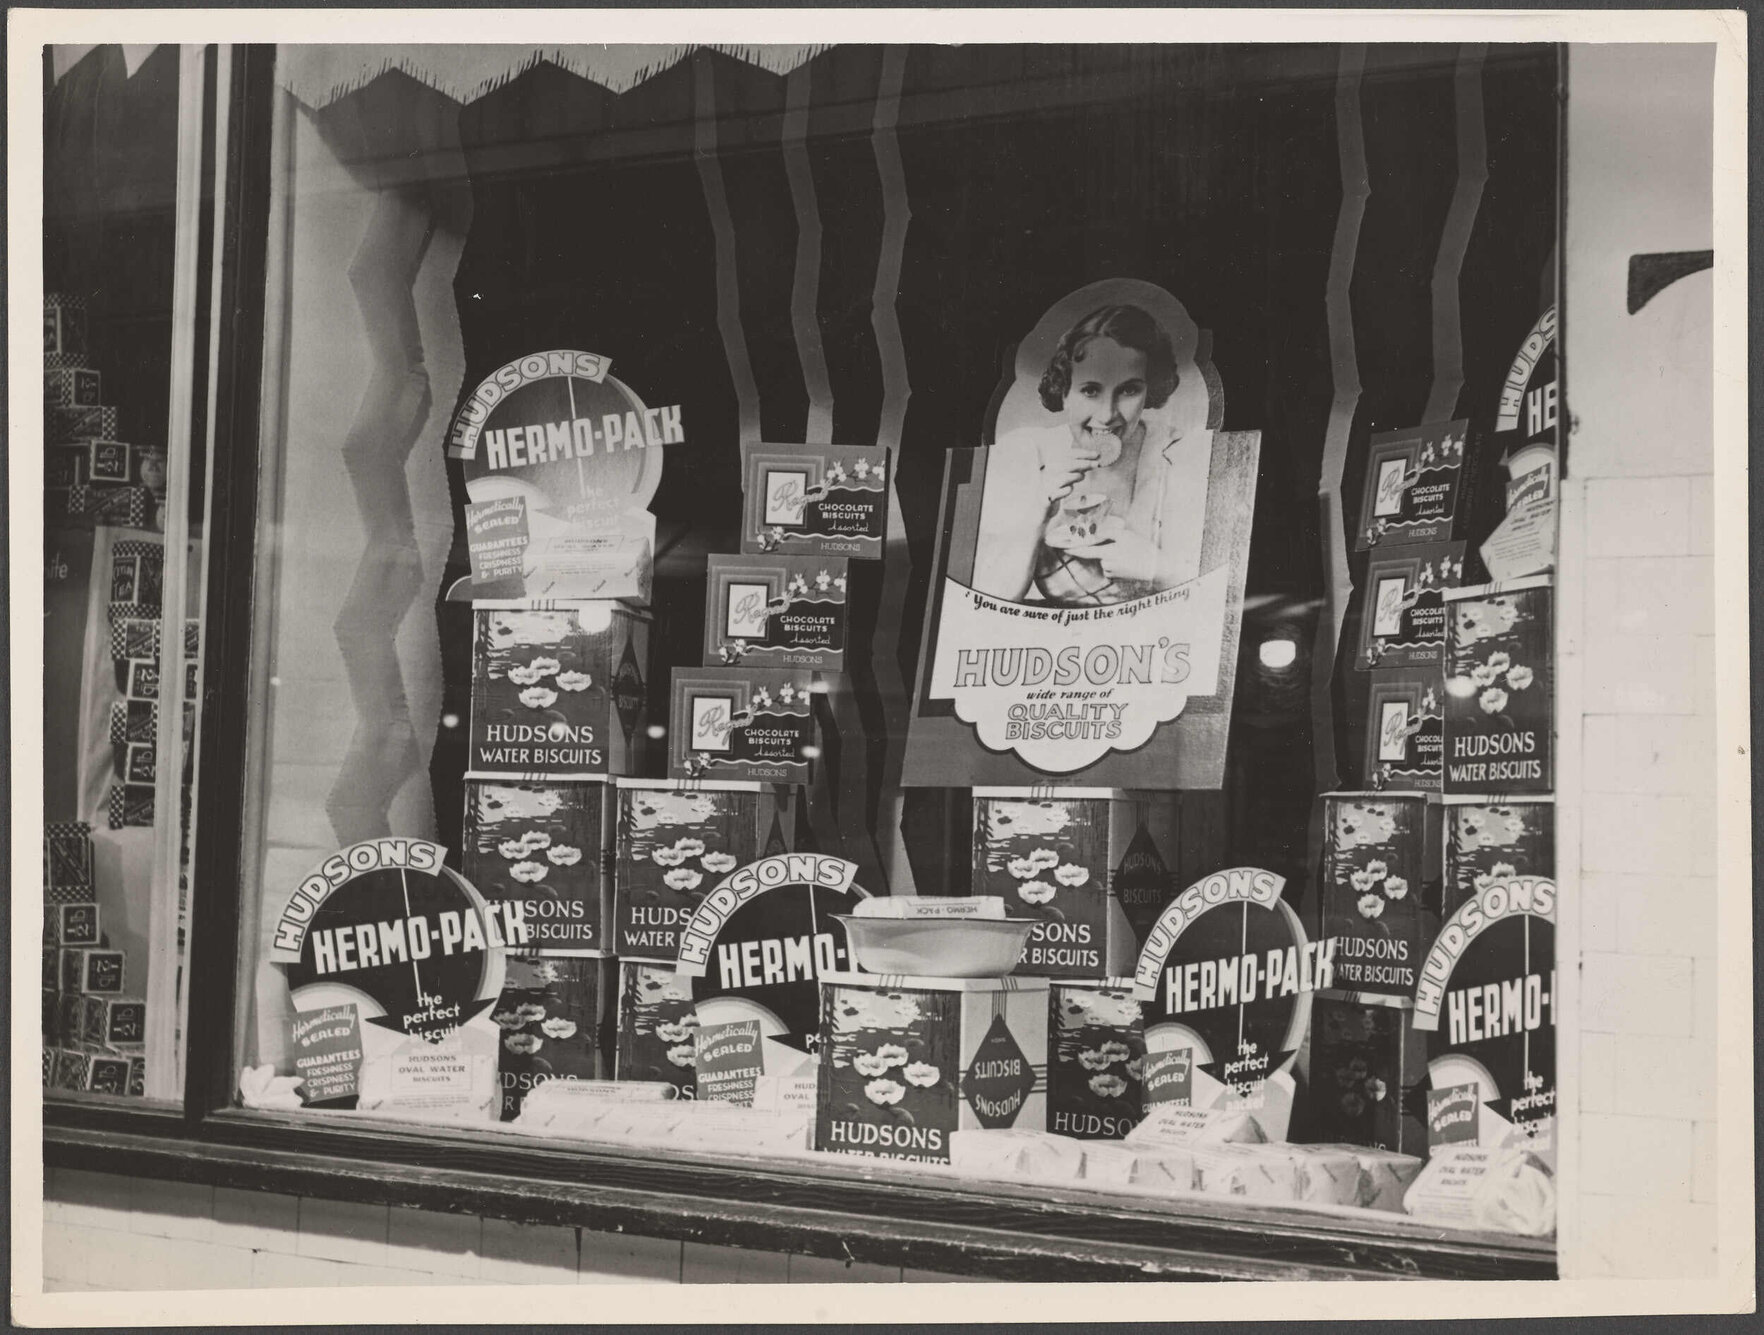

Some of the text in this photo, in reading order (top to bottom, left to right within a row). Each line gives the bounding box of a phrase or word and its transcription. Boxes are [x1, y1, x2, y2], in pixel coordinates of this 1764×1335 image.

[452, 352, 601, 449] HUDSONS
[484, 404, 685, 470] HERMO-PACK
[1410, 483, 1451, 497] CHOCOLATE
[1413, 493, 1444, 505] BISCUITS
[818, 502, 874, 513] CHOCOLATE
[822, 511, 866, 520] BISCUITS
[474, 516, 520, 535] SEALED
[828, 520, 870, 533] Assorted
[470, 535, 529, 552] GUARANTEES
[820, 542, 862, 552] HUDSONS
[479, 548, 522, 560] FRESHNESS
[479, 557, 522, 570] CRISPNESS
[493, 565, 523, 577] PURITY
[1000, 605, 1021, 618] are
[1023, 607, 1049, 621] sure
[1051, 608, 1064, 624] of
[1063, 607, 1090, 627] just
[1093, 604, 1115, 620] the
[1117, 598, 1154, 617] right
[1154, 586, 1191, 606] thing
[780, 615, 836, 625] CHOCOLATE
[784, 624, 828, 633] BISCUITS
[1412, 616, 1444, 626] BISCUITS
[789, 632, 831, 645] Assorted
[782, 654, 824, 665] HUDSONS
[953, 636, 1192, 688] HUDSON'S
[1026, 687, 1115, 702] wide range of
[1007, 702, 1130, 722] QUALITY
[487, 724, 594, 743] HUDSONS
[744, 728, 800, 738] CHOCOLATE
[1005, 720, 1123, 741] BISCUITS
[748, 737, 792, 746] BISCUITS
[1454, 731, 1536, 758] HUDSONS
[480, 747, 602, 764] WATER BISCUITS
[754, 746, 796, 758] Assorted
[747, 767, 788, 777] HUDSONS
[1449, 759, 1542, 782] WATER BISCUITS
[273, 840, 437, 952] HUDSONS
[680, 856, 846, 965] HUDSONS
[312, 900, 529, 975] HERMO-PACK
[527, 923, 593, 940] BISCUITS
[624, 930, 675, 947] WATER
[1136, 870, 1276, 989] HUDSONS
[1336, 935, 1409, 961] HUDSONS
[1416, 879, 1556, 1016] HUDSONS
[1031, 947, 1099, 968] BISCUITS
[1165, 936, 1338, 1015] HERMO-PACK
[1364, 963, 1415, 987] BISCUITS
[417, 991, 443, 1008] the
[1448, 970, 1556, 1046] HERMO-
[292, 1004, 357, 1043] Hermetically
[403, 1001, 461, 1029] perfect
[301, 1026, 351, 1048] SEALED
[409, 1021, 460, 1045] biscuit
[695, 1020, 759, 1057] Hermetically
[703, 1042, 753, 1062] SEALED
[1237, 1038, 1258, 1056] the
[296, 1048, 362, 1069] GUARANTEES
[408, 1054, 457, 1063] HUDSONS
[1141, 1049, 1192, 1086] Hermetically
[1224, 1050, 1270, 1079] perfect
[307, 1062, 353, 1077] FRESHNESS
[399, 1064, 466, 1074] OVAL WATER
[698, 1066, 762, 1083] GUARANTEES
[974, 1058, 1021, 1080] BISCUITS
[307, 1073, 354, 1089] CRISPNESS
[412, 1075, 451, 1083] BISCUITS
[707, 1079, 754, 1093] FRESHNESS
[1147, 1072, 1186, 1092] SEALED
[1226, 1074, 1267, 1098] biscuit
[1524, 1070, 1544, 1091] the
[323, 1083, 356, 1096] PURITY
[707, 1089, 755, 1101] CRISPNESS
[783, 1092, 810, 1100] OVAL
[975, 1088, 1021, 1118] HUDSONS
[1511, 1086, 1556, 1117] perfect
[1433, 1109, 1473, 1133] SEALED
[830, 1120, 943, 1150] HUDSONS
